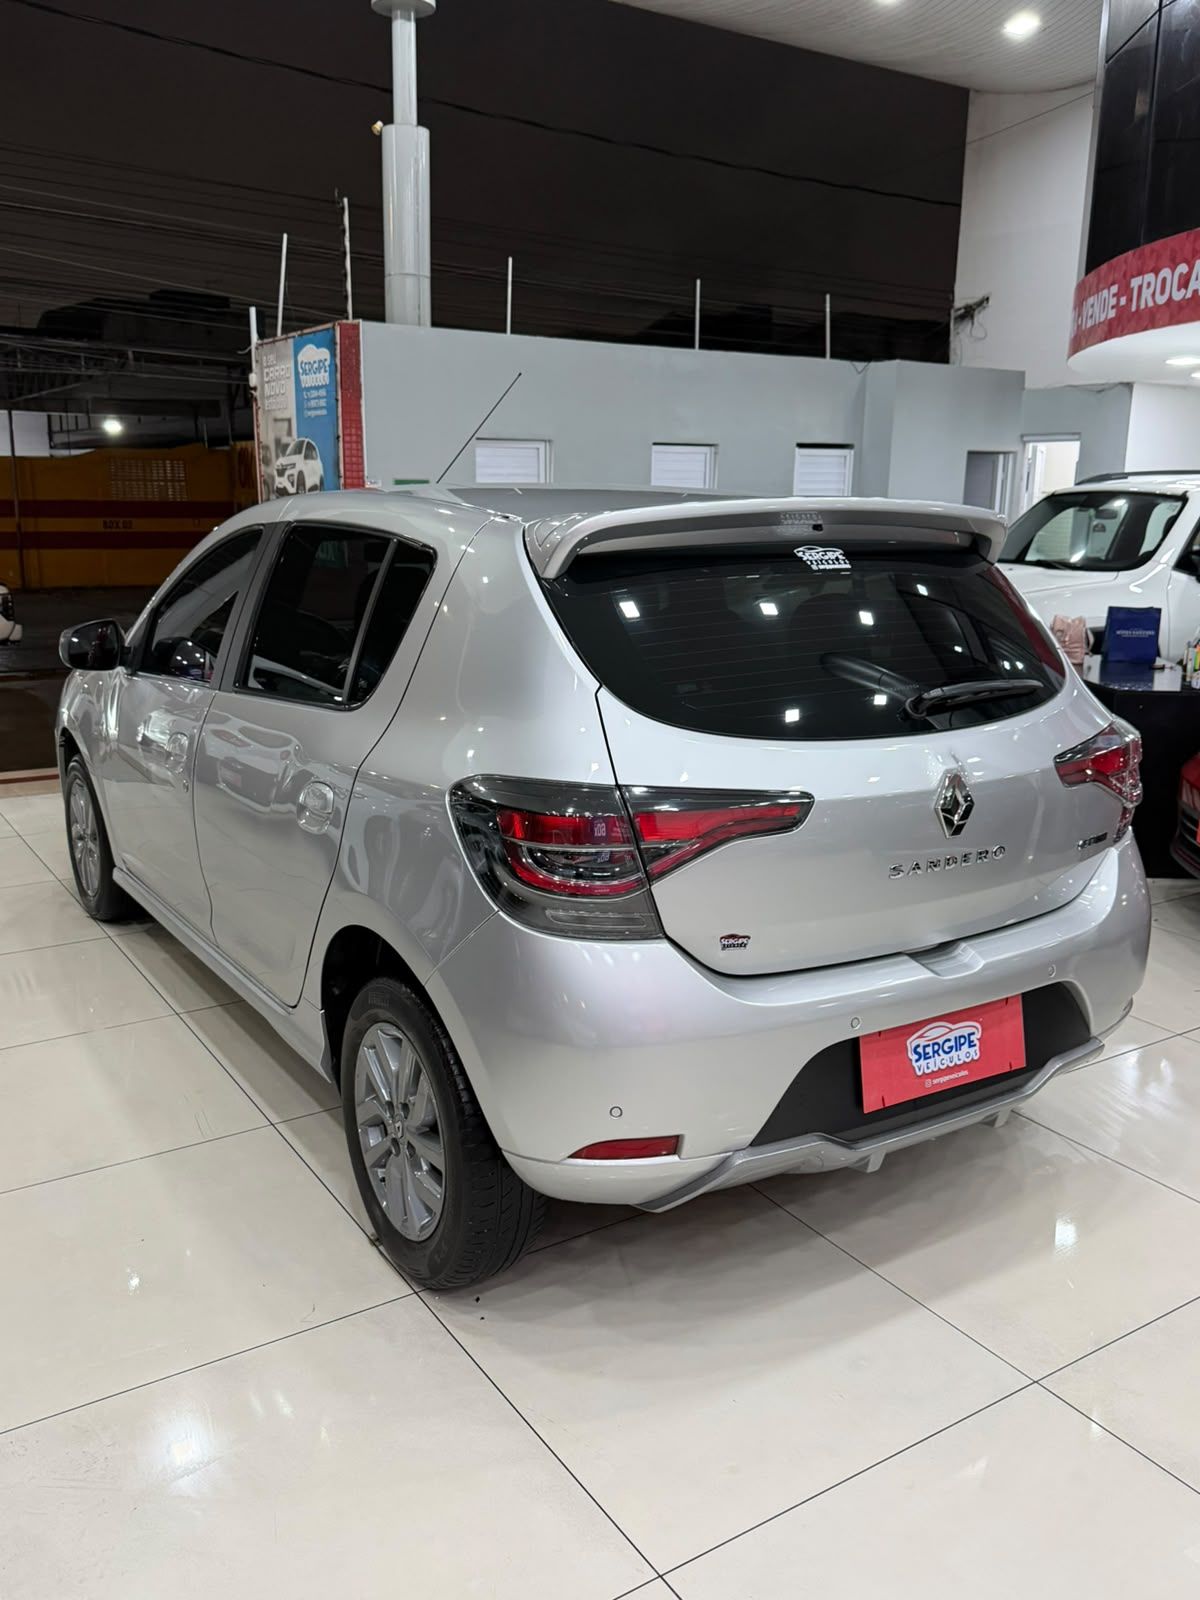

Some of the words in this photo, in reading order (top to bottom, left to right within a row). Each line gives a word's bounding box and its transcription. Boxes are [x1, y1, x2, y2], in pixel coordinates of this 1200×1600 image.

[299, 358, 328, 375] SERGIPE
[888, 845, 1007, 880] SANDERO
[913, 1031, 977, 1063] SERGIPE
